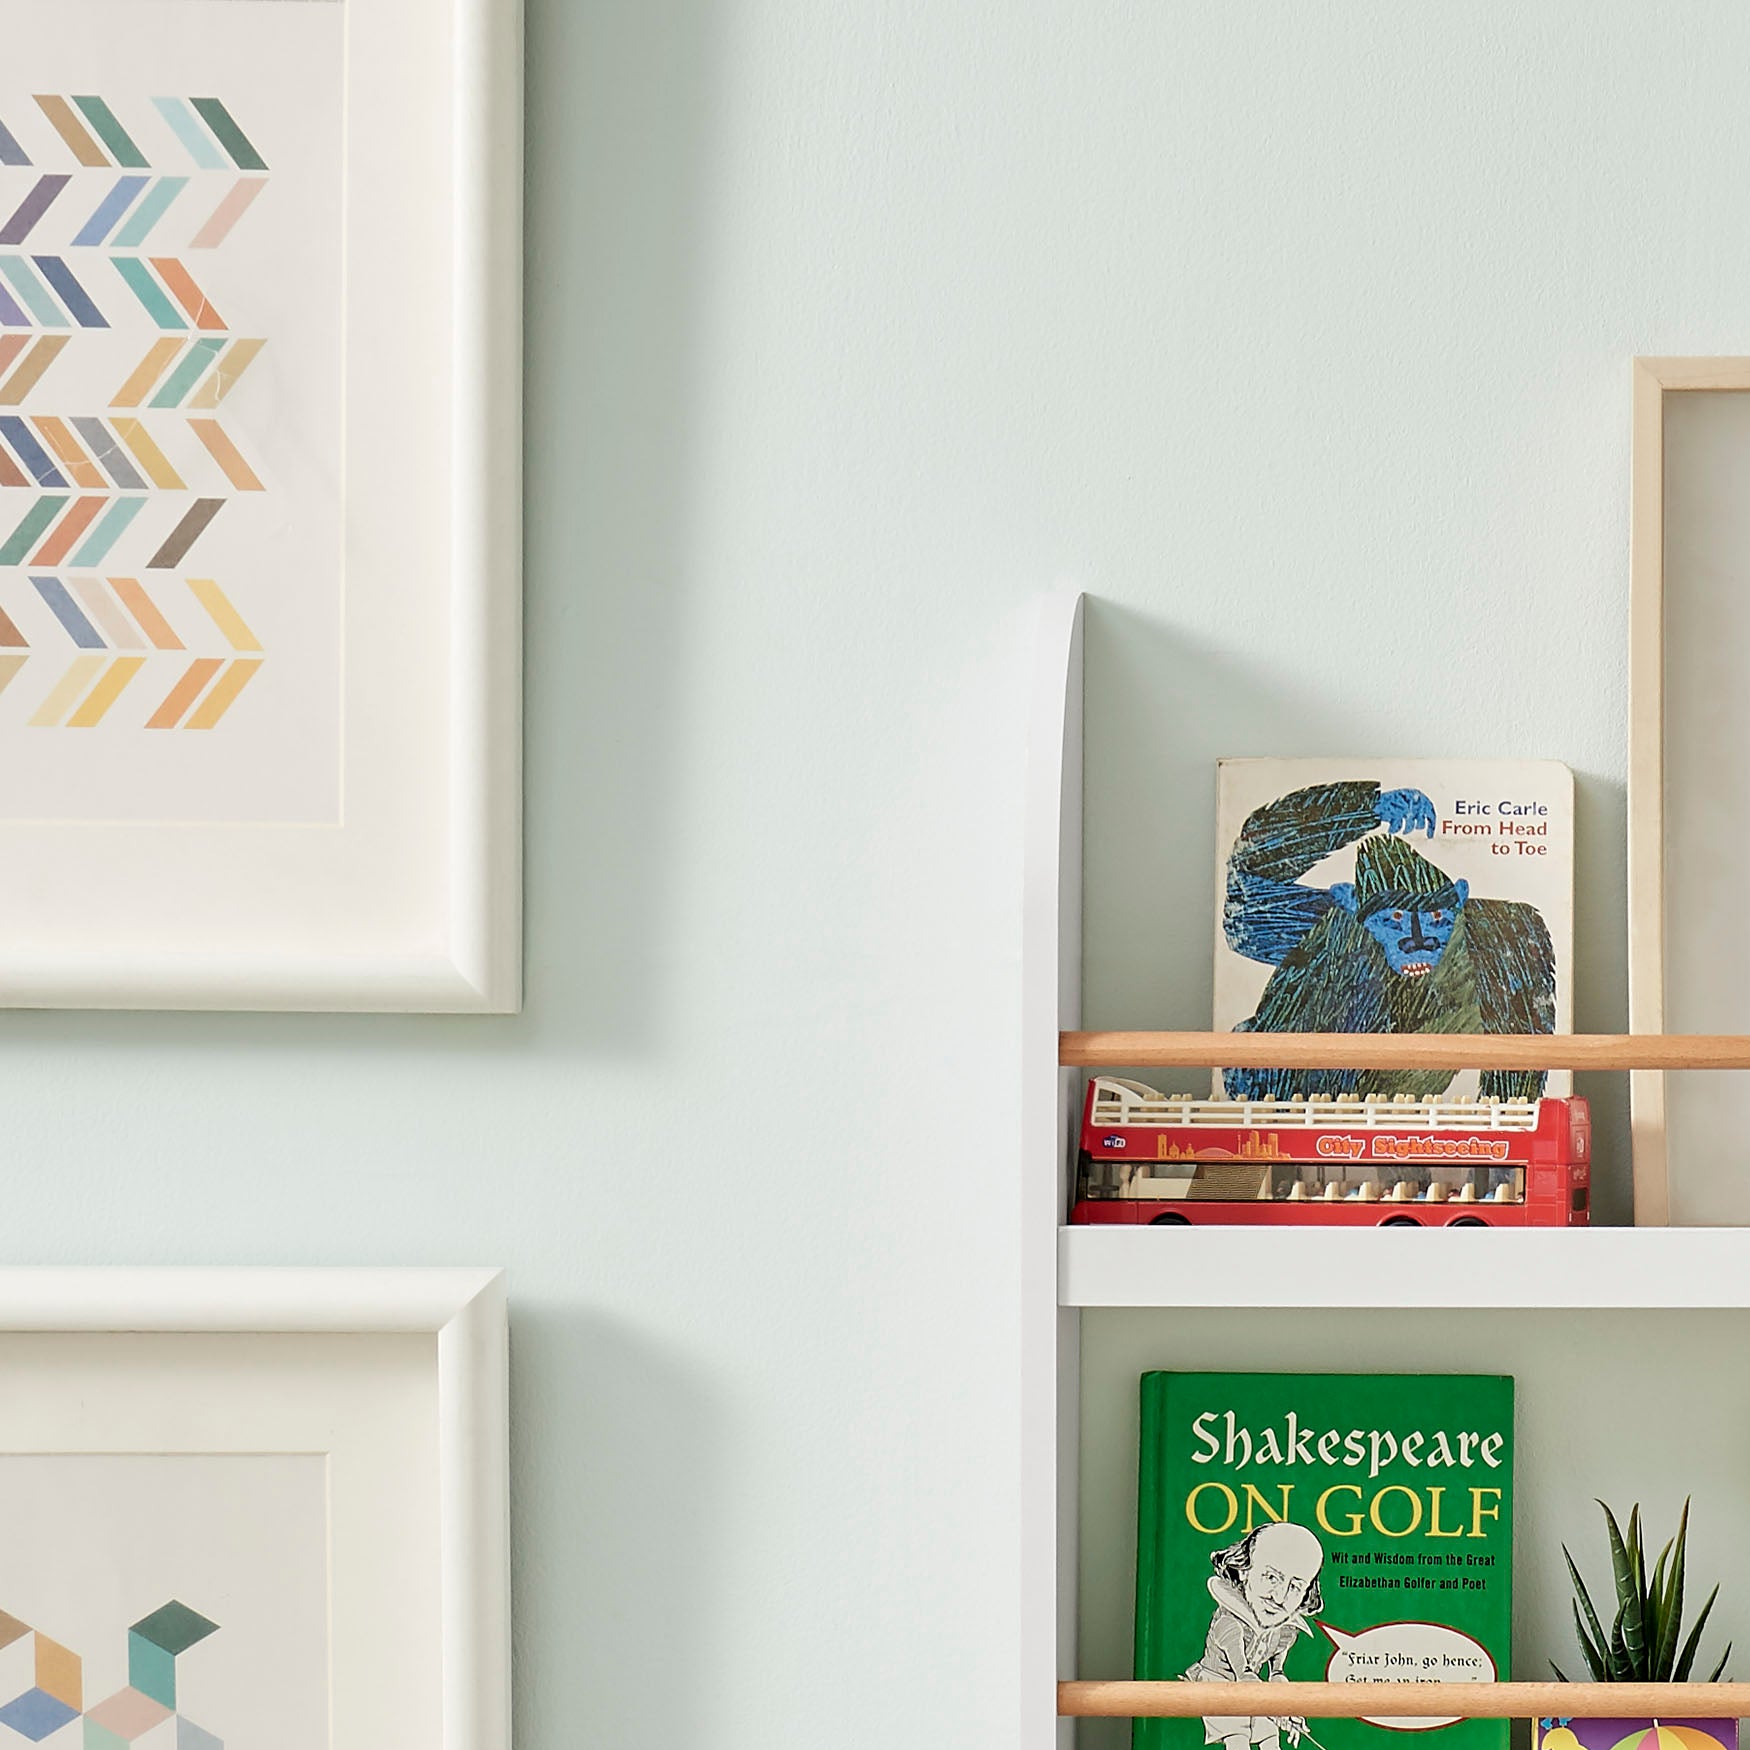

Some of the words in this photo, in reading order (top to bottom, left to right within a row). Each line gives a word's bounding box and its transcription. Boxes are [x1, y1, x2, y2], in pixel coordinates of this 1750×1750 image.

[1455, 800, 1491, 816] Eric
[1497, 800, 1548, 816] Carle
[1441, 820, 1492, 836] From
[1499, 821, 1548, 836] Head
[1491, 842, 1510, 855] to
[1513, 841, 1547, 856] Toe
[1317, 1135, 1365, 1158] City
[1373, 1136, 1509, 1159] Sightseeing
[1190, 1409, 1504, 1479] Shakespeare
[1185, 1481, 1295, 1534] ON
[1315, 1484, 1503, 1538] GOLF
[1330, 1551, 1349, 1565] Wit
[1351, 1552, 1371, 1565] and
[1374, 1552, 1415, 1565] Wisdom
[1417, 1553, 1443, 1566] from
[1446, 1553, 1463, 1566] the
[1466, 1553, 1496, 1567] Great
[1339, 1575, 1401, 1589] Elizabethan
[1404, 1576, 1437, 1590] Golfer
[1439, 1577, 1459, 1590] and
[1461, 1577, 1487, 1590] Poet
[1384, 1652, 1418, 1668] John,
[1422, 1655, 1438, 1670] go
